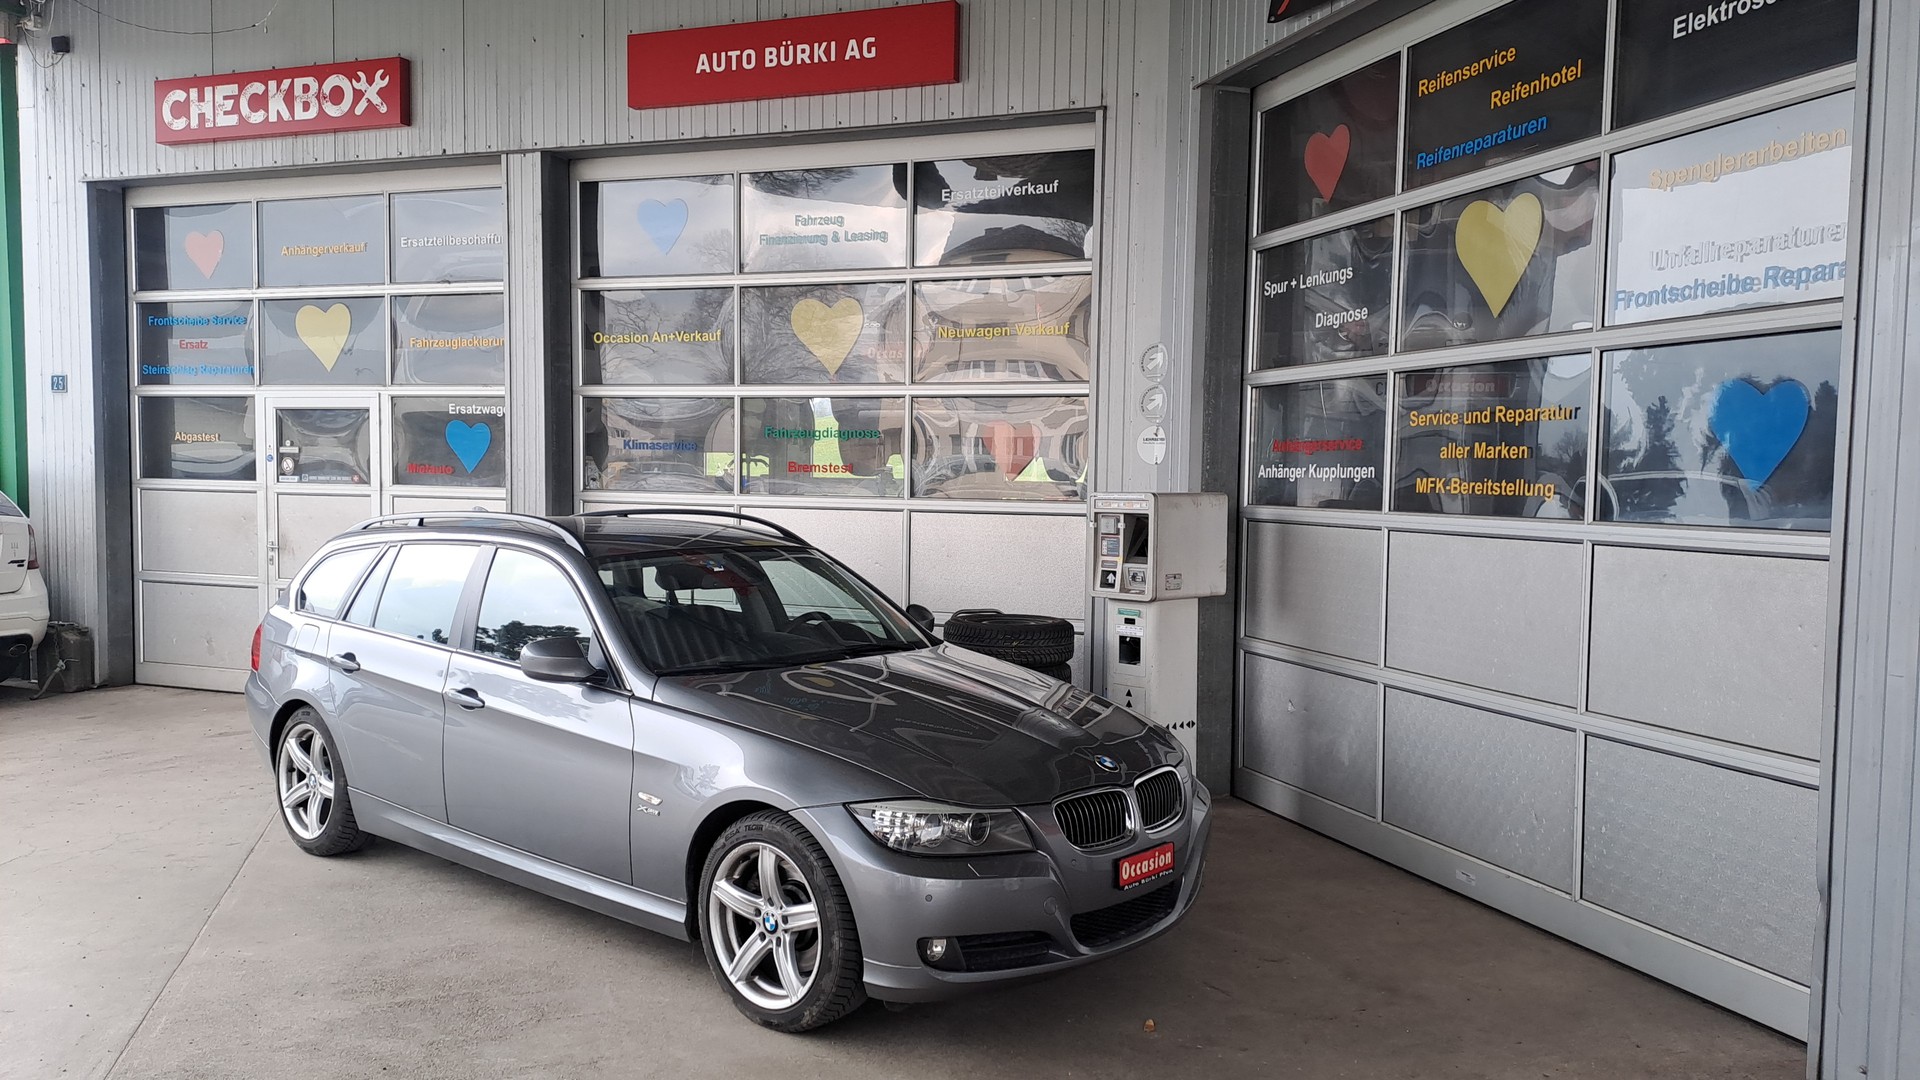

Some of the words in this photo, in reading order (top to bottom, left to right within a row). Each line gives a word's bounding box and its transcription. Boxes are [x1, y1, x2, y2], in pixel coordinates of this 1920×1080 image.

[1673, 0, 1776, 39] Elektros
[695, 49, 756, 74] AUTO
[764, 40, 836, 68] BÜRKI
[844, 37, 876, 61] AG
[1418, 47, 1516, 97] Reifenservice
[1490, 59, 1582, 109] Reifenhotel
[162, 69, 390, 131] CHECKBOX
[1416, 116, 1548, 170] Reifenreparaturen
[1650, 128, 1847, 191] Spenglerarbeiten
[941, 180, 1059, 202] Ersatzteilverkauf
[794, 215, 845, 228] Fahrzeug
[400, 233, 504, 248] Ersatzteilbeschaffu
[759, 233, 828, 246] Finanzierung
[831, 230, 841, 243] &
[844, 229, 889, 243] Leasing
[1264, 280, 1288, 299] Spur
[1290, 278, 1297, 289] +
[1300, 266, 1354, 289] Lenkungs
[1614, 273, 1759, 311] Frontscheibe
[148, 315, 209, 326] Frontscheibe
[211, 314, 248, 326] Service
[1315, 306, 1369, 329] Diagnose
[593, 331, 649, 344] Occasion
[651, 329, 722, 343] An+Verkauf
[938, 325, 1011, 340] Neuwagen
[1014, 322, 1070, 336] Verkauf
[179, 339, 208, 350] Ersatz
[142, 363, 197, 376] Steinschlag
[53, 376, 64, 391] 25
[1409, 409, 1459, 427] Service
[1463, 407, 1491, 425] und
[1495, 404, 1575, 427] Reparatur
[174, 431, 220, 444] Abgastest
[763, 426, 881, 441] Fahrzeugdiagnose
[623, 439, 698, 451] Klimaservice
[1439, 443, 1470, 459] aller
[1474, 441, 1528, 459] Marken
[787, 461, 853, 474] Bremstest
[1258, 463, 1306, 482] Anhänger
[1308, 463, 1375, 483] Kupplungen
[1416, 477, 1555, 501] MFK-Bereitstellung
[1122, 851, 1171, 880] Occasion
[1124, 882, 1140, 891] Auto
